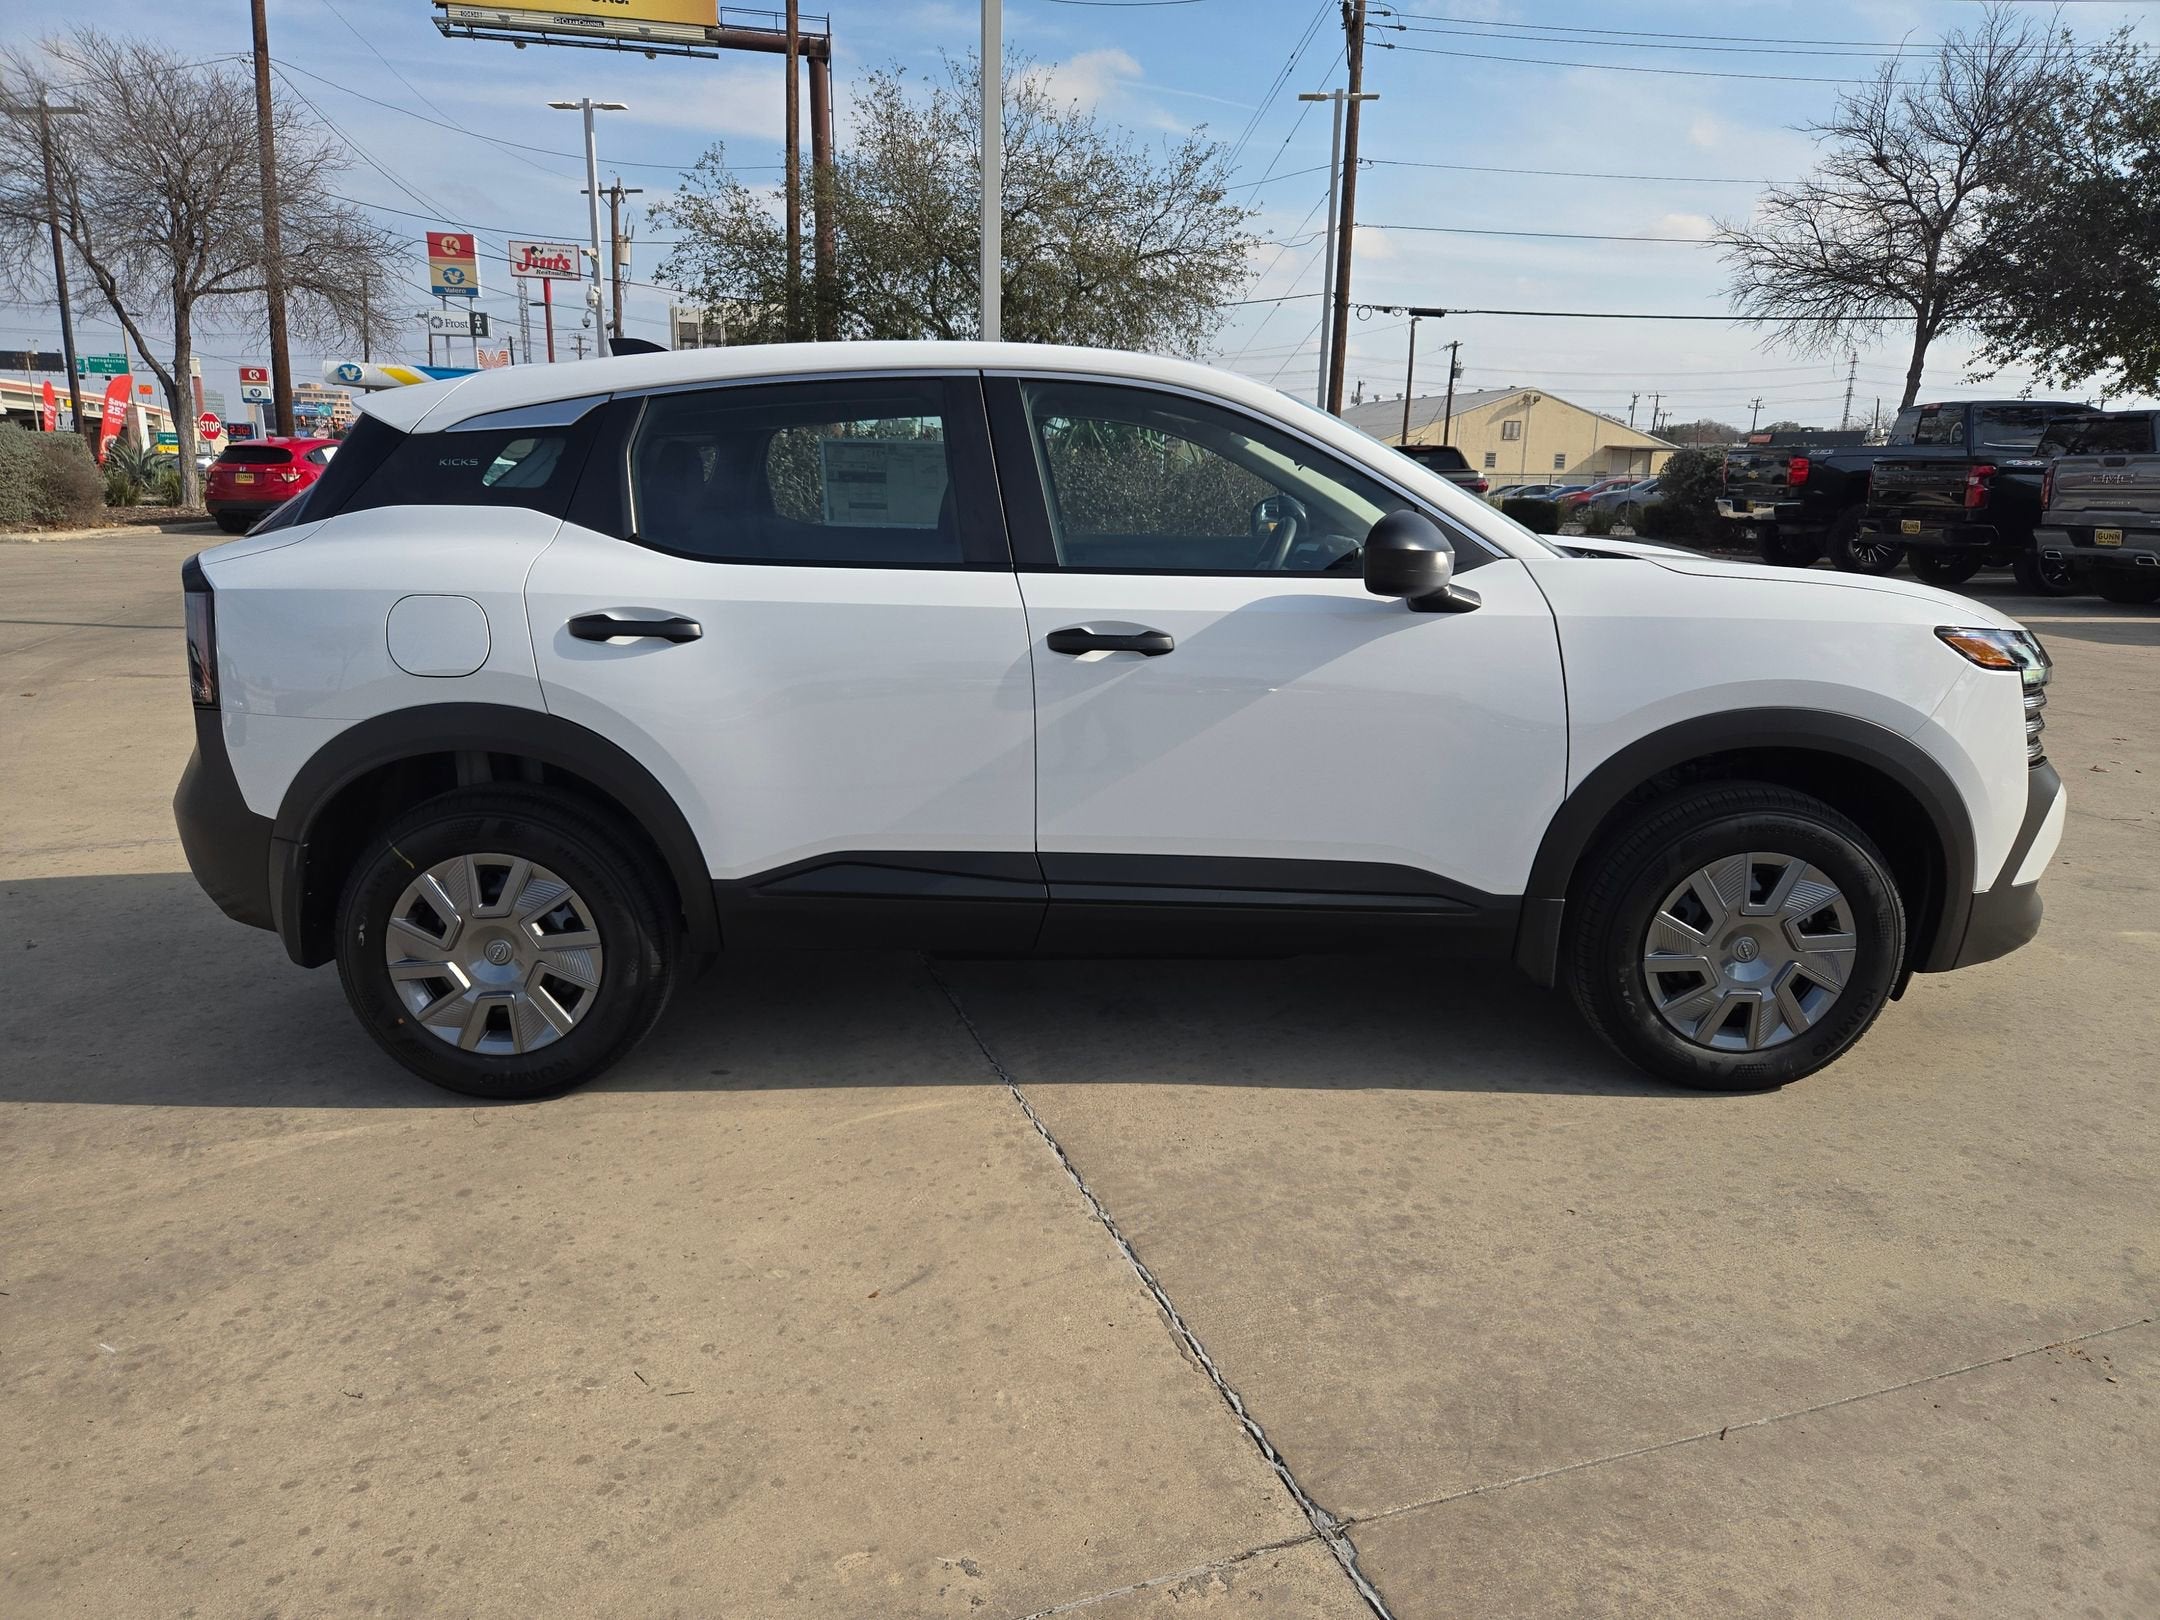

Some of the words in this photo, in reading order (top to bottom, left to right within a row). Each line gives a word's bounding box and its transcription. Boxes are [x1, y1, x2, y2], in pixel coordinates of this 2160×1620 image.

[516, 247, 571, 272] Jim's
[444, 318, 469, 329] Frost
[474, 314, 483, 335] ATM
[108, 397, 127, 409] Save
[200, 421, 220, 432] STOP
[439, 458, 479, 466] KICKS
[2097, 532, 2120, 540] GUNN
